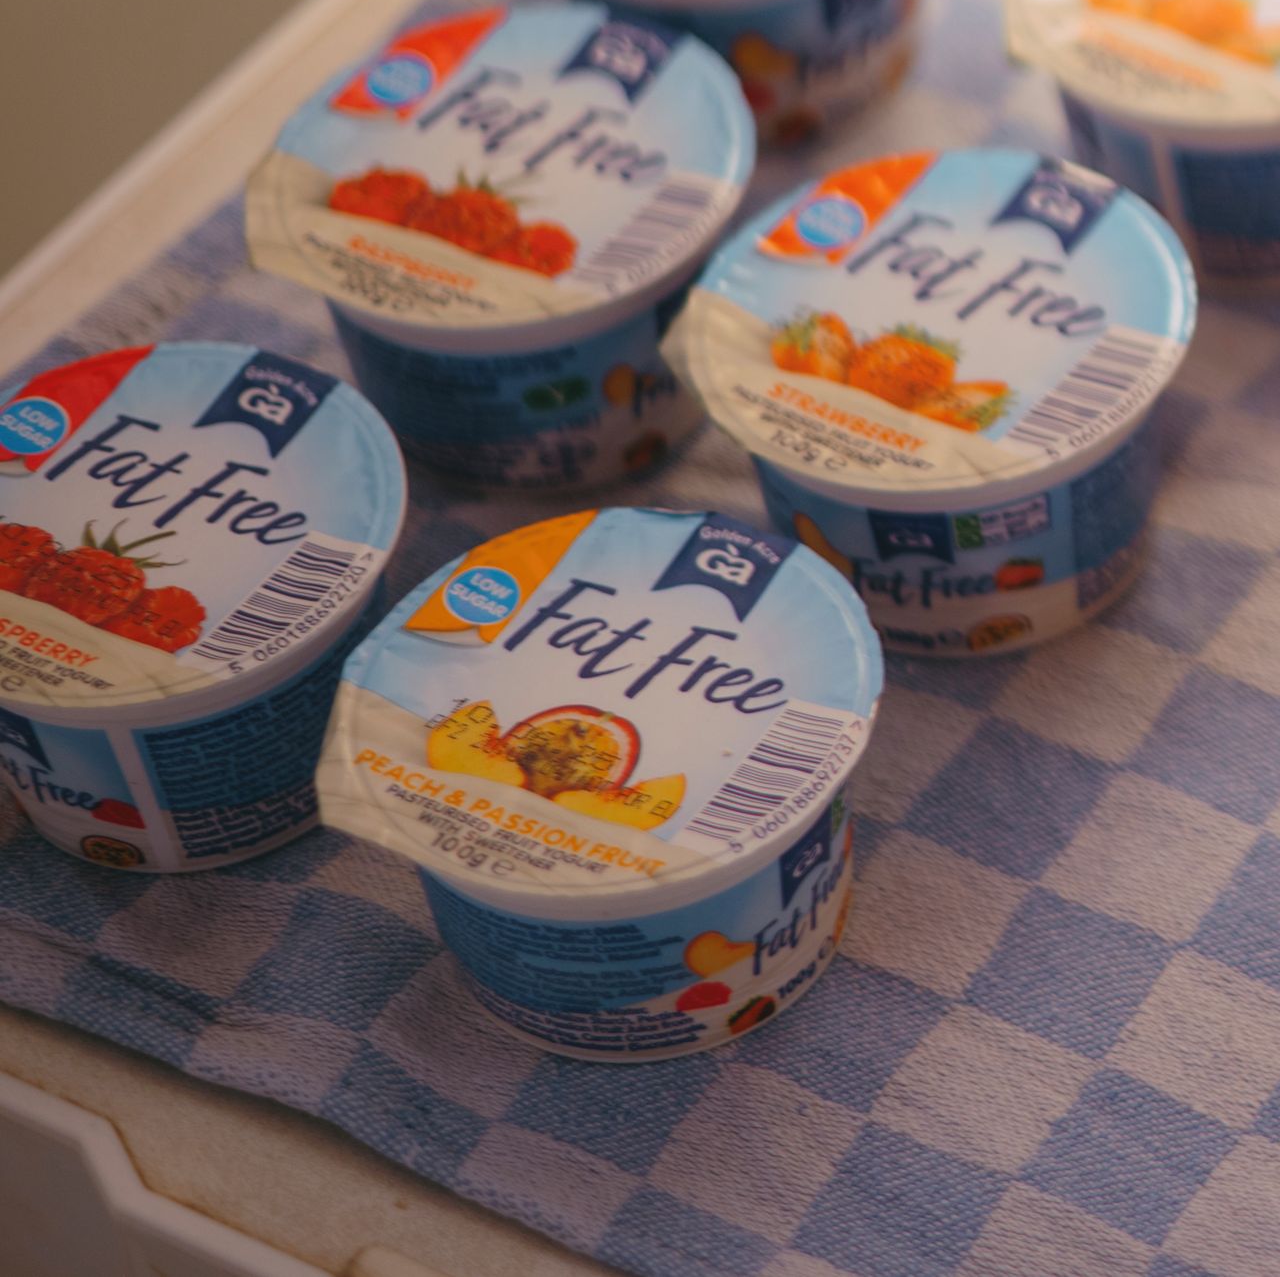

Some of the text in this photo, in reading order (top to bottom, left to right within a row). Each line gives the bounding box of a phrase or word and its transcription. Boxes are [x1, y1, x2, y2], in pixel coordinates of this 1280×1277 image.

[417, 65, 549, 154] Fat
[521, 108, 668, 183] Free
[847, 211, 985, 302] Fat
[956, 258, 1107, 337] Free
[19, 406, 60, 431] LOW
[767, 382, 926, 452] STRAWBERRY
[45, 414, 308, 546] Fat Free
[449, 583, 509, 617] SUGAR
[470, 572, 514, 600] LOW
[503, 578, 788, 715] Fat Free
[353, 749, 447, 802] PEACH
[444, 789, 468, 808] &
[470, 798, 589, 853] PASSION
[587, 844, 666, 877] FRUIT
[385, 783, 612, 874] PASTEURISED FRUIT YOGURT
[418, 811, 556, 872] WITH SWEETENER
[431, 832, 489, 868] 100g
[753, 908, 802, 976] Fat
